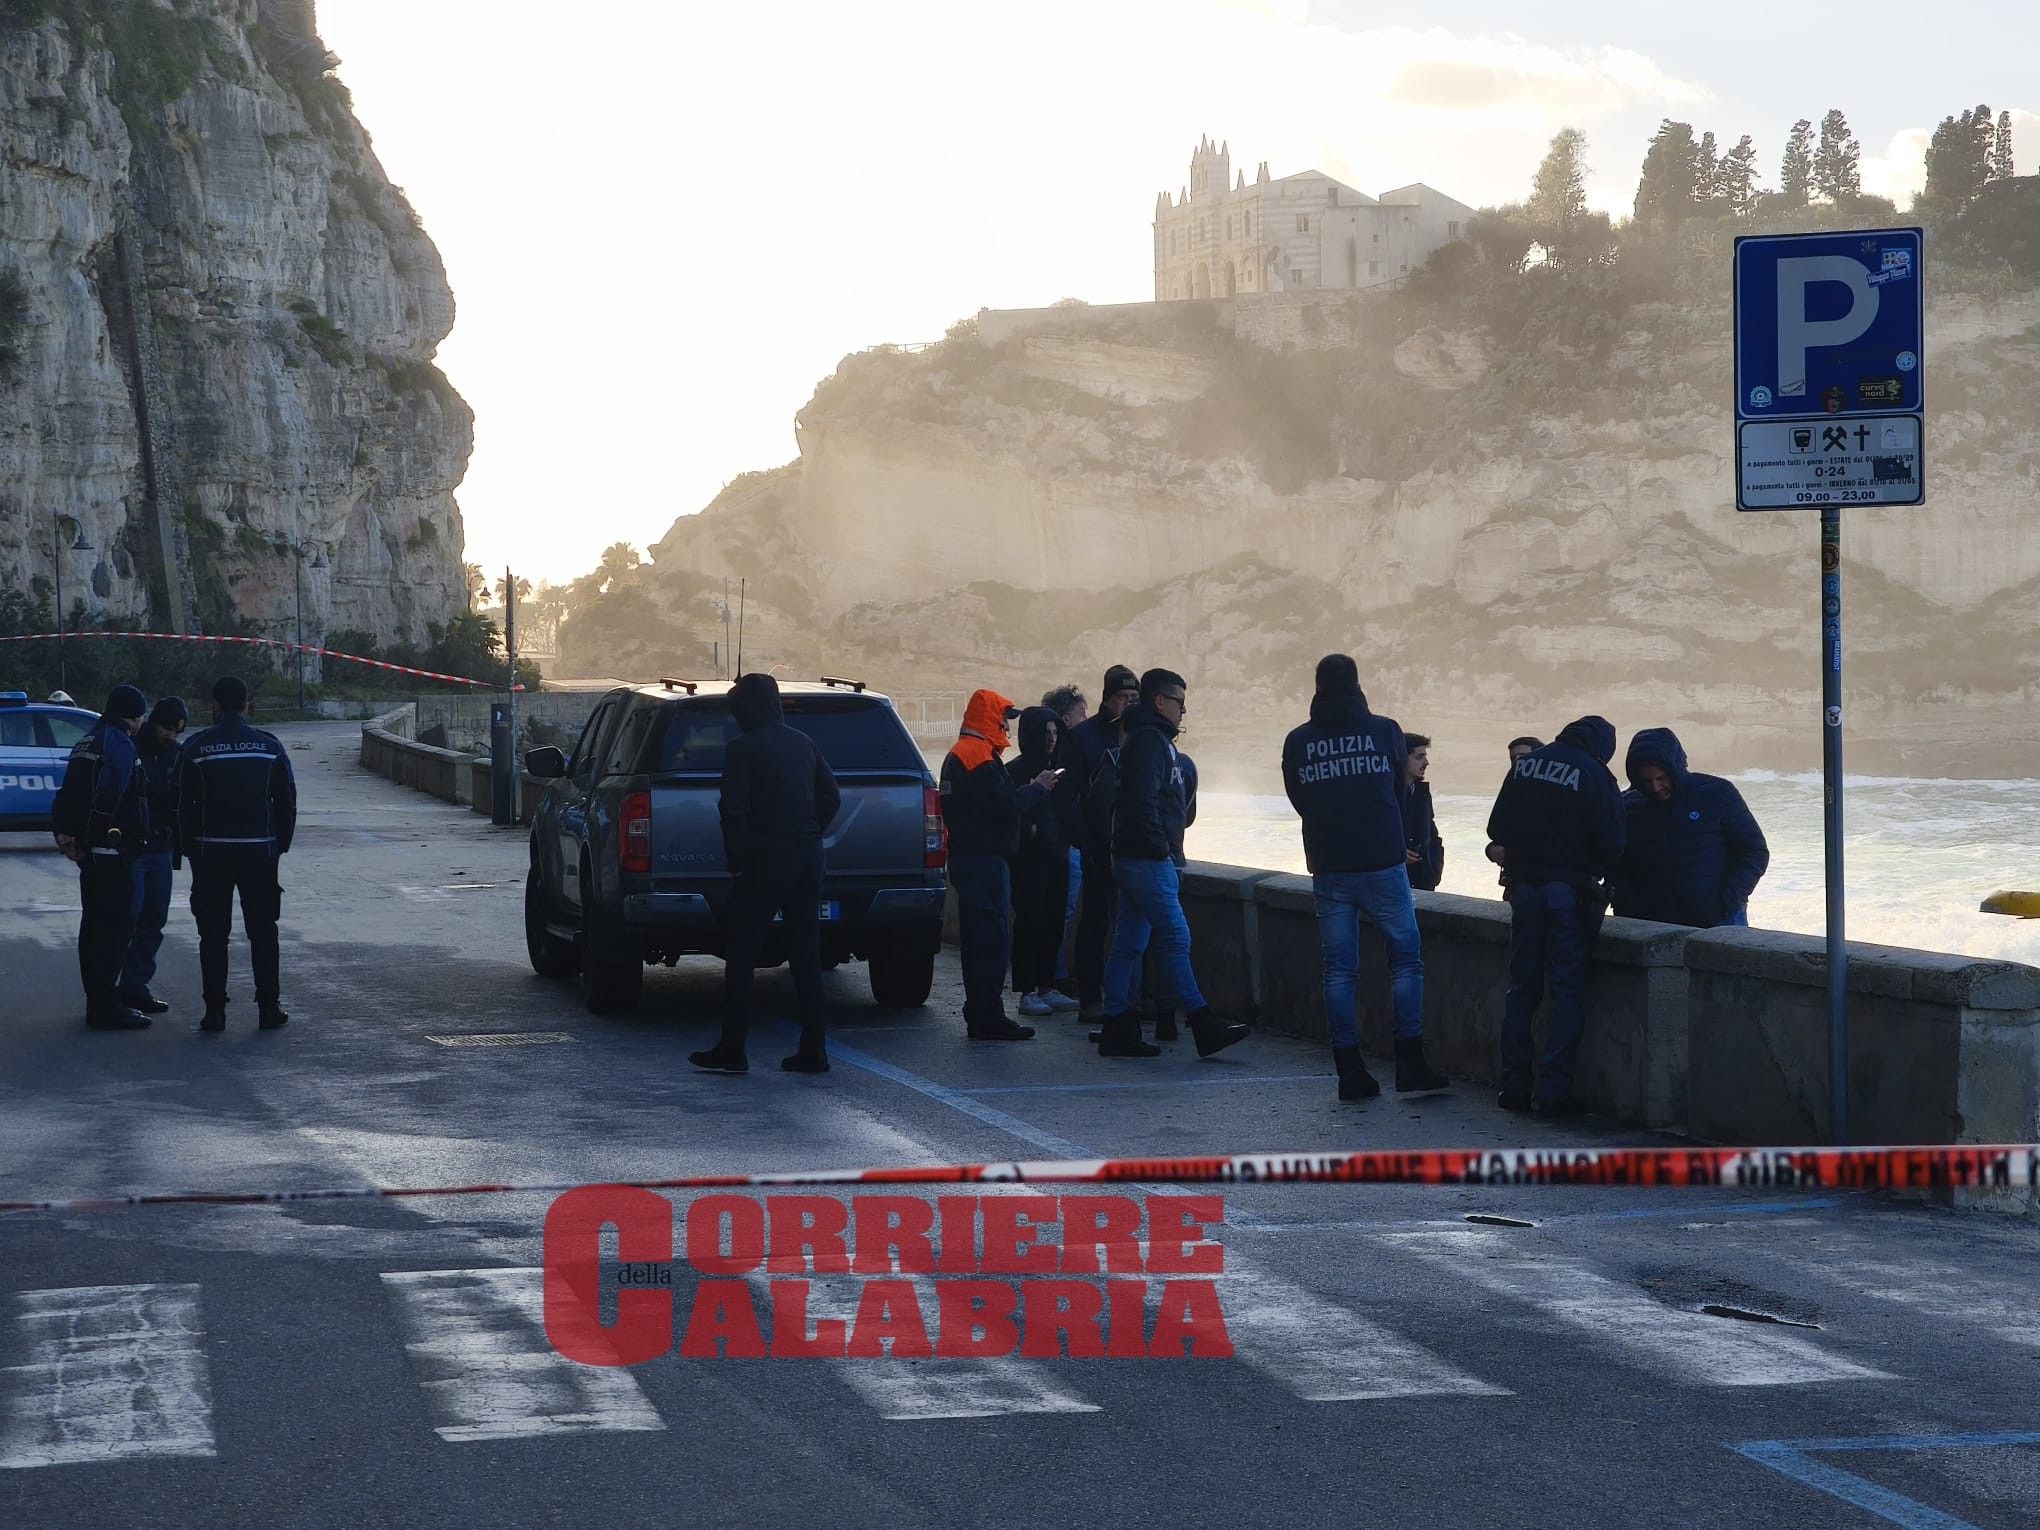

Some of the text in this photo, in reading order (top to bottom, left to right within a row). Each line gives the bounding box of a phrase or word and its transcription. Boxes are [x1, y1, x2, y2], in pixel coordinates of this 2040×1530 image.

[1777, 255, 1879, 396] P
[1753, 460, 1785, 468] pagamento
[1830, 456, 1851, 465] ESTATE
[1853, 456, 1863, 464] dal
[1815, 466, 1845, 477] 0-24
[1752, 482, 1784, 491] pagamento
[1786, 481, 1800, 489] tutti
[1829, 479, 1856, 488] INVERNO
[1858, 478, 1868, 487] dal
[1796, 492, 1830, 503] 09,00
[1841, 491, 1875, 502] 23,00
[200, 742, 267, 753] POLIZIA LOCALE
[1306, 735, 1375, 760] POLIZIA
[1298, 755, 1391, 785] SCIENTIFICA
[1513, 757, 1581, 792] POLIZIA
